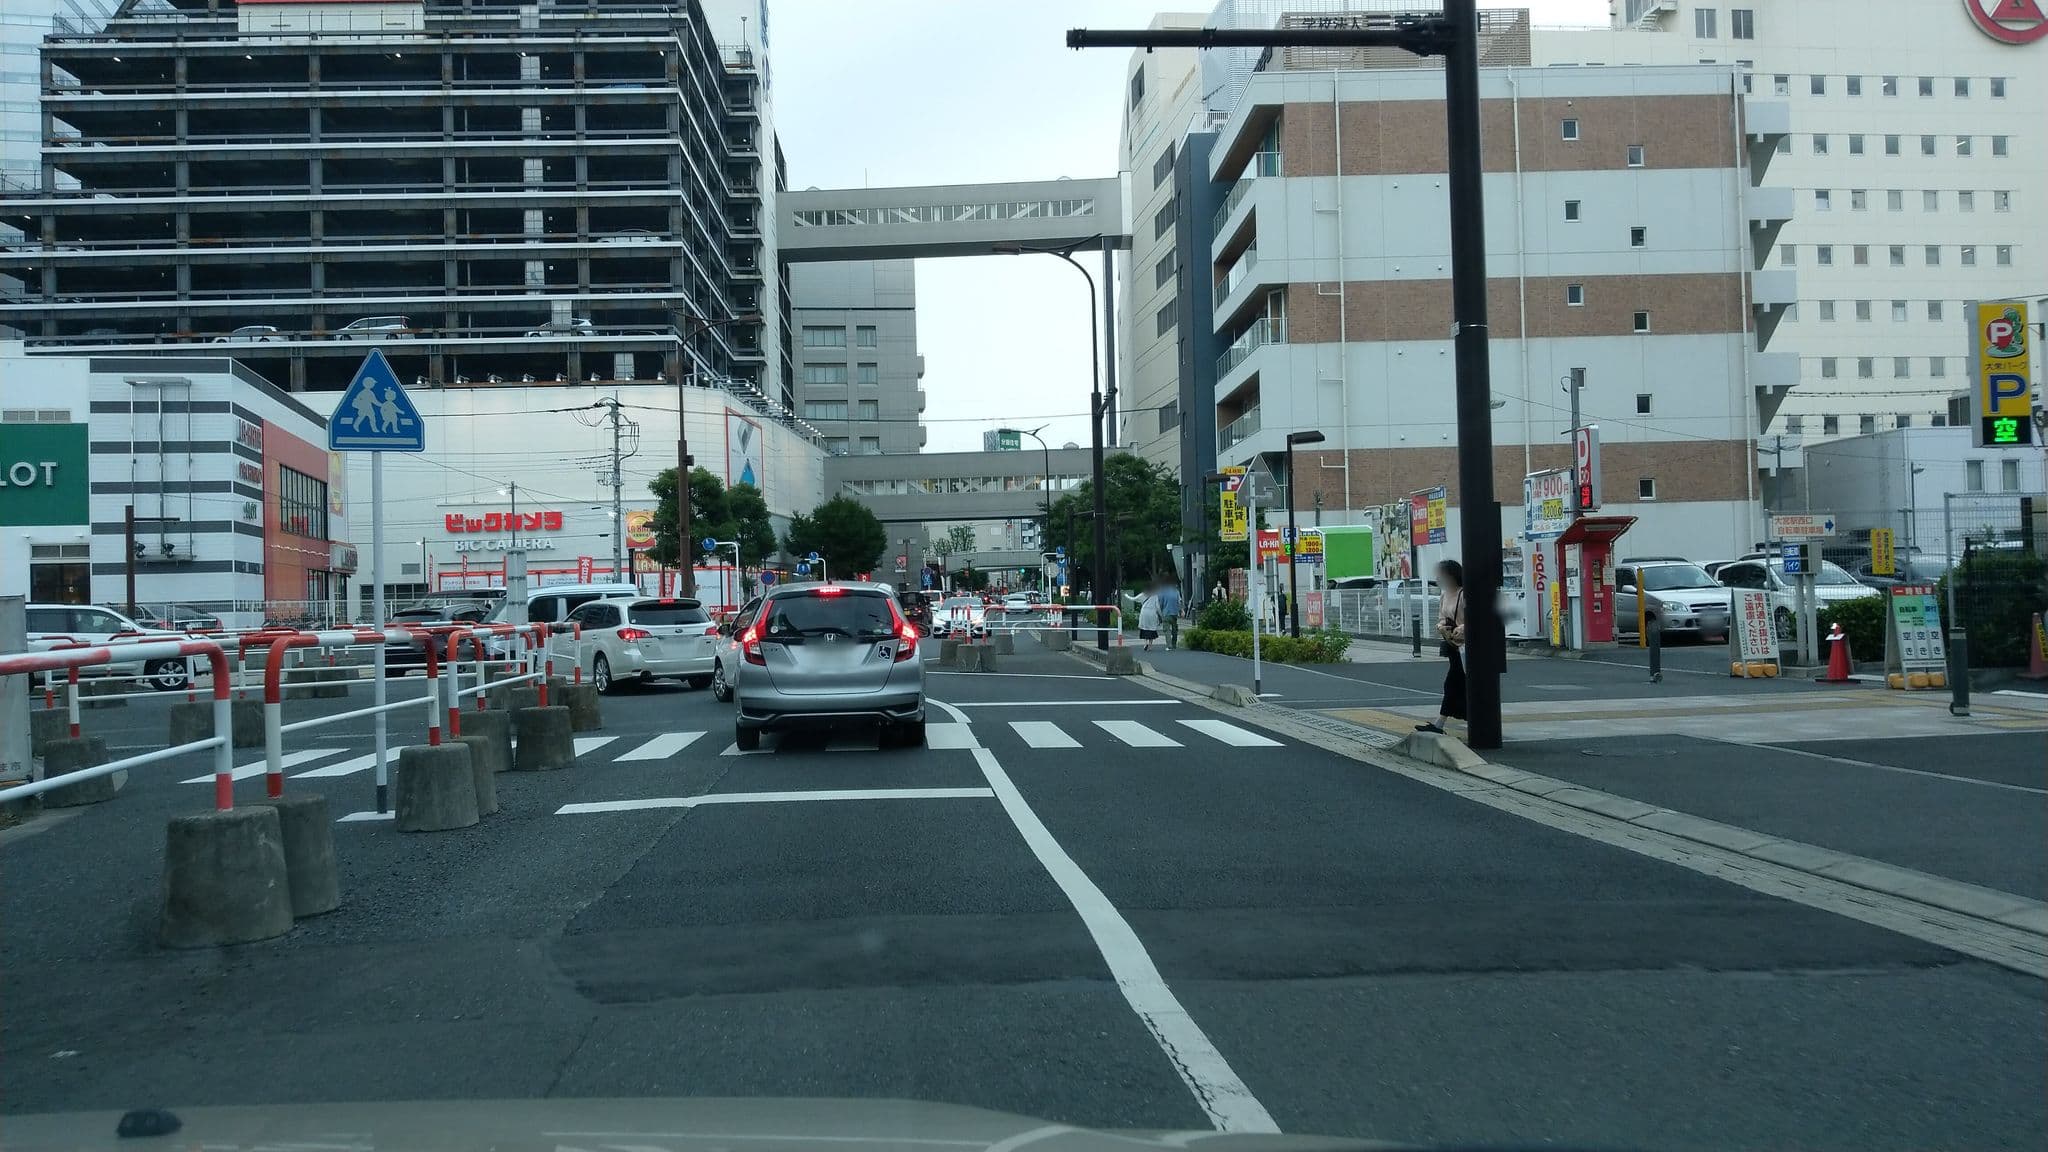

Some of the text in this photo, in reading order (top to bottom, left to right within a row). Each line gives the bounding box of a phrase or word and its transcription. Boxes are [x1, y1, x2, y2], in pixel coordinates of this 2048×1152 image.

[1989, 374, 2026, 413] P
[1993, 417, 2018, 442] 空
[445, 511, 563, 533] ビックカメラ
[1223, 500, 1235, 528] 駐車場
[1775, 516, 1814, 525] 大宮駅西口
[455, 538, 556, 552] BIC CAMERA
[1536, 553, 1547, 592] DyDo
[1784, 560, 1800, 572] バイク
[1895, 586, 1933, 595] 一時駐車
[1744, 592, 1761, 655] ご遠慮ください
[1754, 592, 1771, 655] 場内通り抜けは
[1902, 631, 1914, 656] 空き
[1916, 631, 1928, 656] 空き
[1930, 630, 1942, 655] 空き
